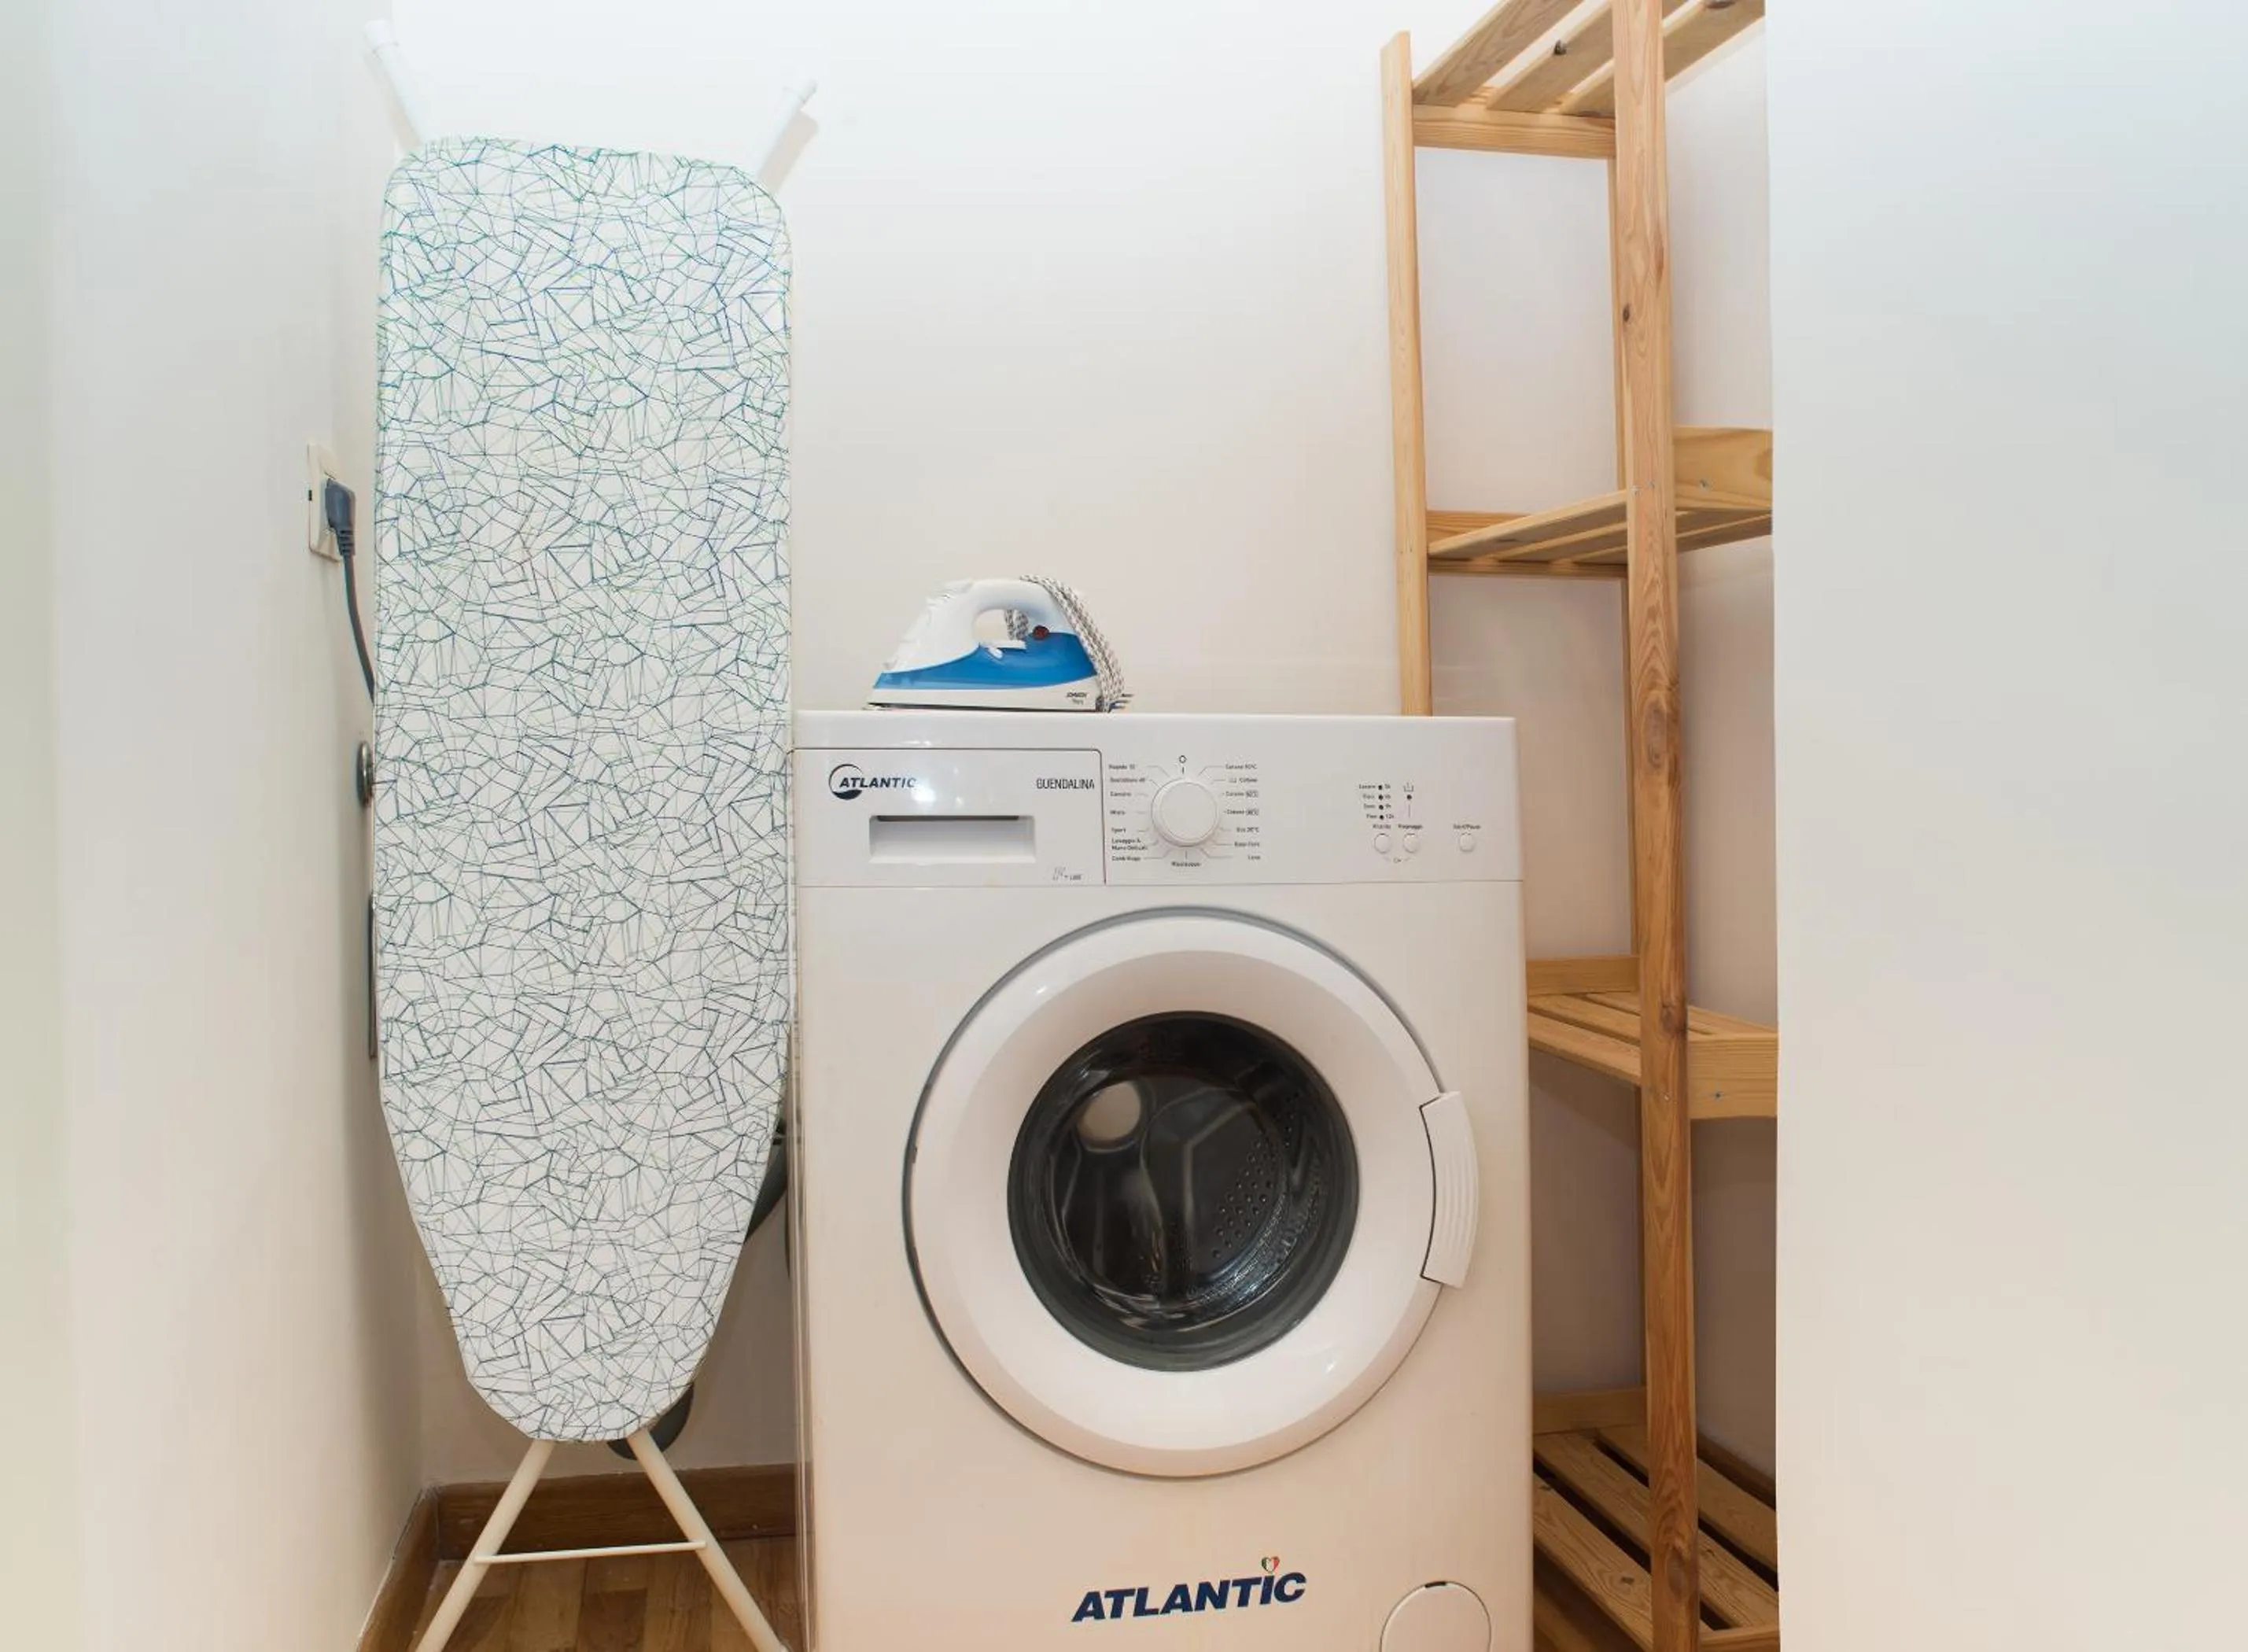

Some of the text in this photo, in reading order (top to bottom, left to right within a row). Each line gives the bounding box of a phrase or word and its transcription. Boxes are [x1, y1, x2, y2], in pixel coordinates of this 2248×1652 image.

[838, 776, 917, 788] ATLANTIC
[1036, 777, 1095, 790] GUENDALINA
[1071, 1570, 1307, 1623] ATLANTIC
